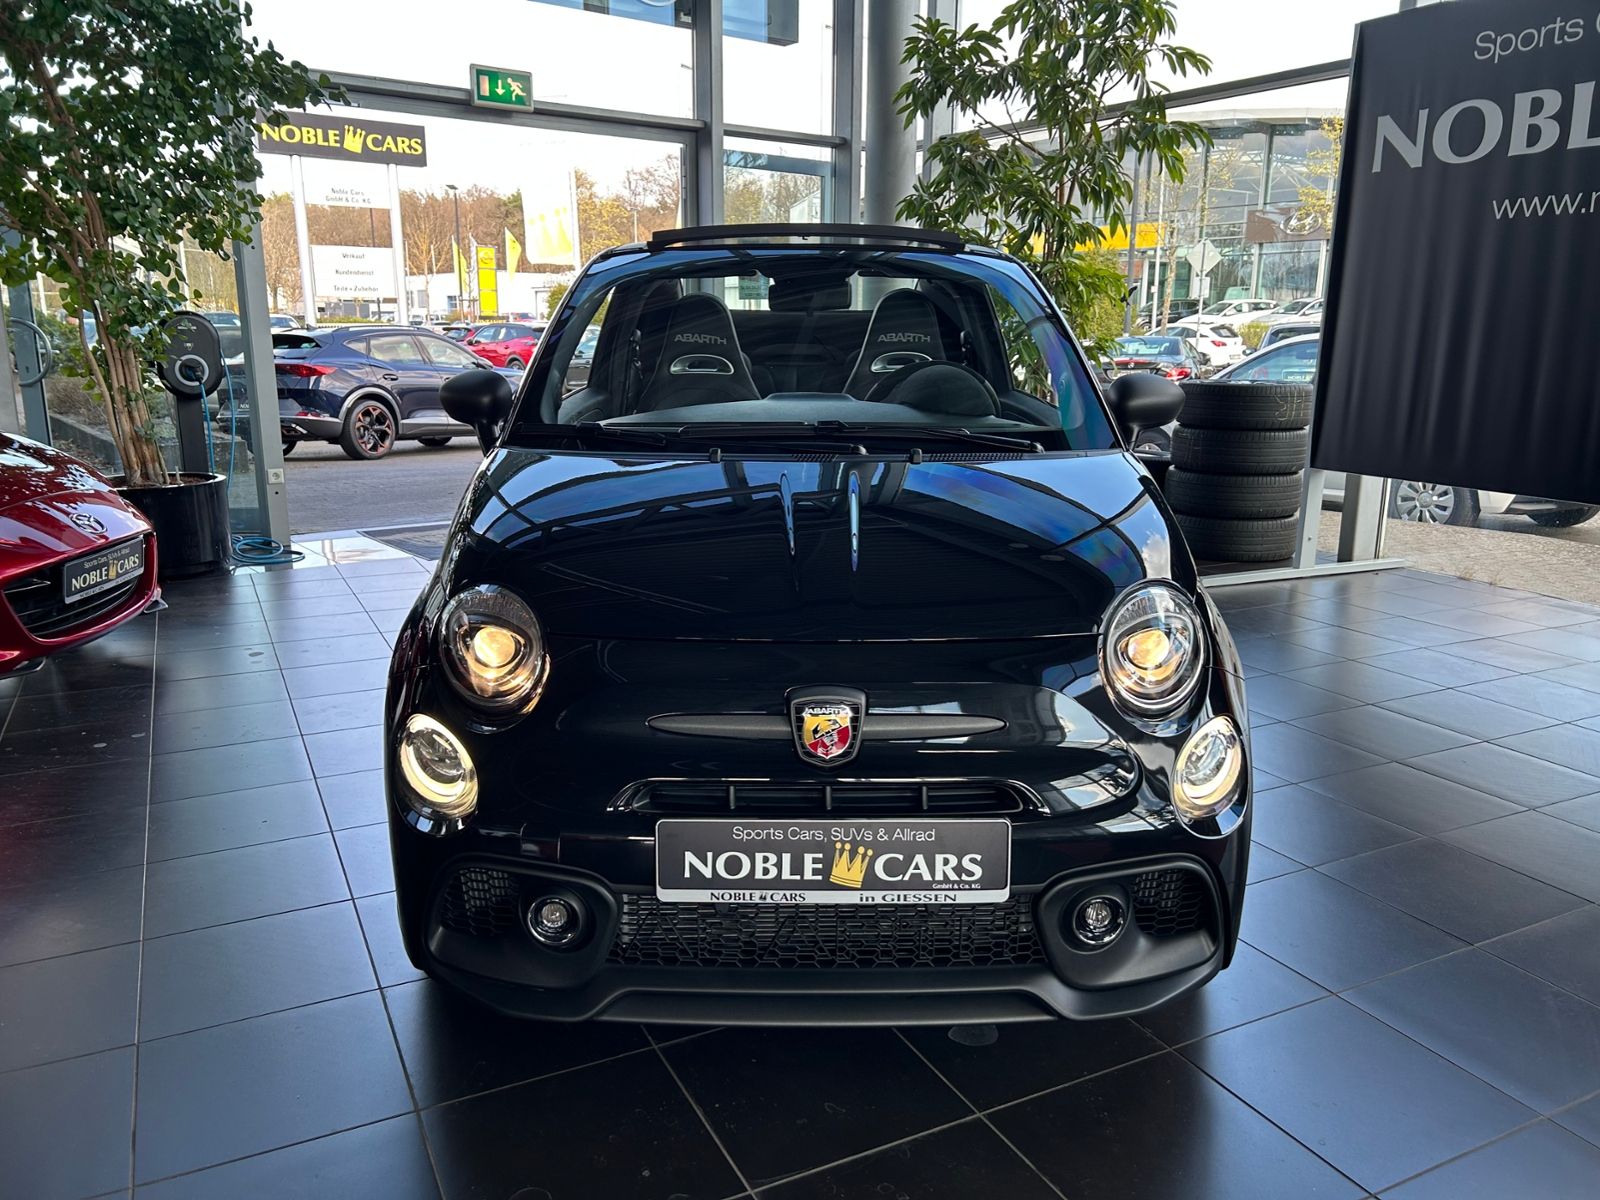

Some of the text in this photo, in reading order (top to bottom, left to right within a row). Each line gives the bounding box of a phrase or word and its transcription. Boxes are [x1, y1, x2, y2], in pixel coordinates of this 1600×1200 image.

[1474, 17, 1584, 63] Sports
[261, 123, 423, 155] NOBLE CARS
[674, 333, 727, 345] ABARTH
[877, 332, 931, 343] ABARTH
[72, 566, 108, 591] NOBLE
[117, 554, 139, 573] CARS
[732, 826, 936, 843] Sports Cars, SUVs & Allrad
[684, 851, 984, 881] NOBLE CARS
[710, 892, 807, 902] NOBLE CARS
[859, 893, 957, 902] in GIESSEN
